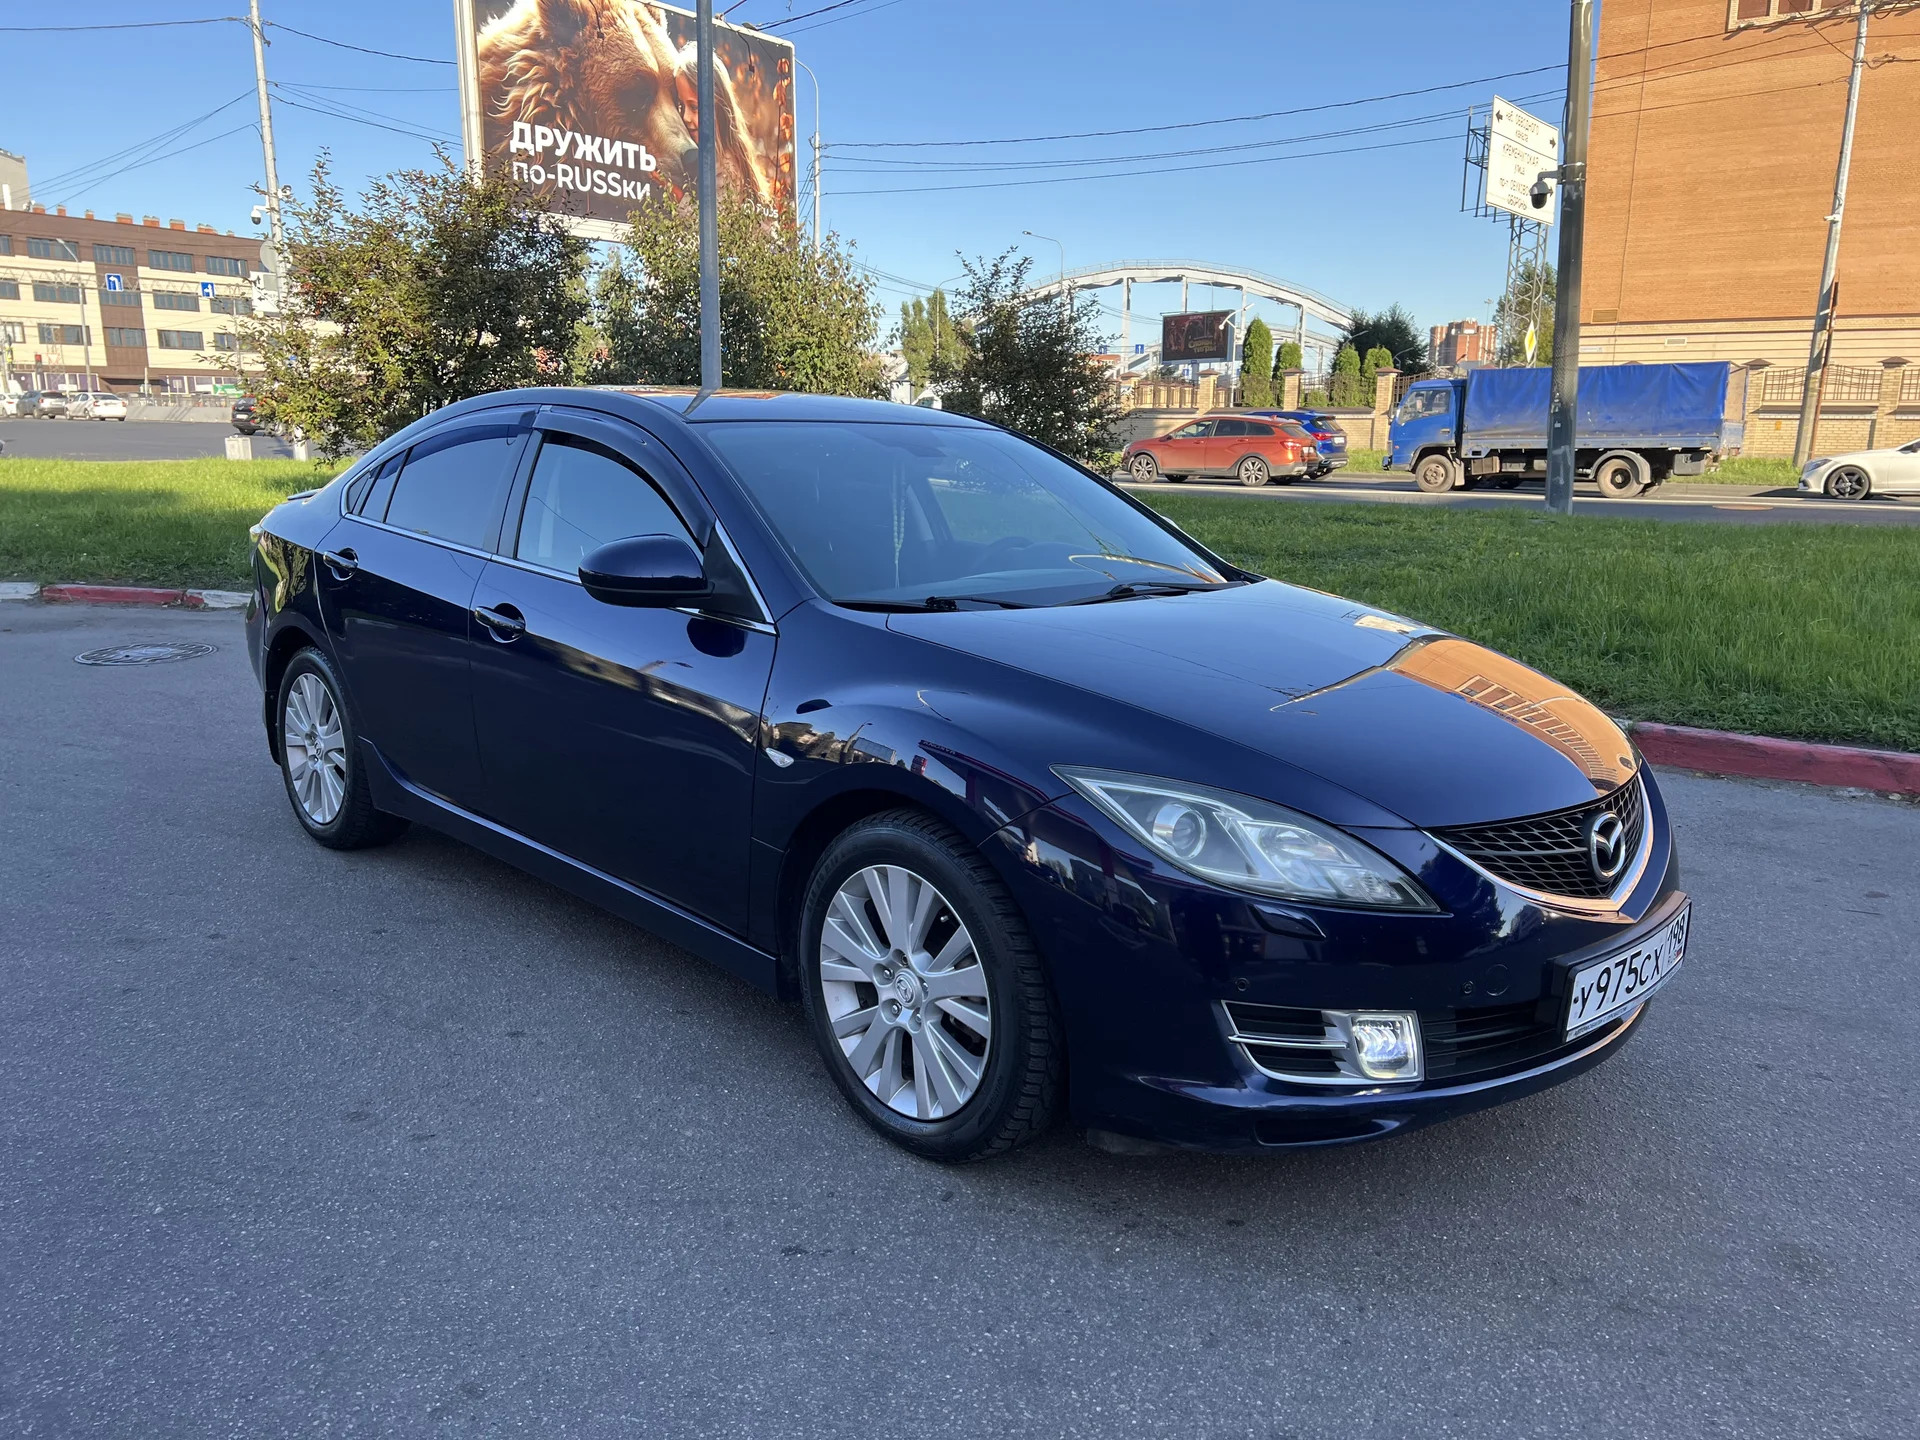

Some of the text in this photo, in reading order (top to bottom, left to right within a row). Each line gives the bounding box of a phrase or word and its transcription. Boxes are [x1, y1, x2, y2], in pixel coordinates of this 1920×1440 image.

[510, 121, 656, 172] ДРУЖИТЬ
[1578, 943, 1664, 1019] У975СХ
[1667, 913, 1685, 954] 198
